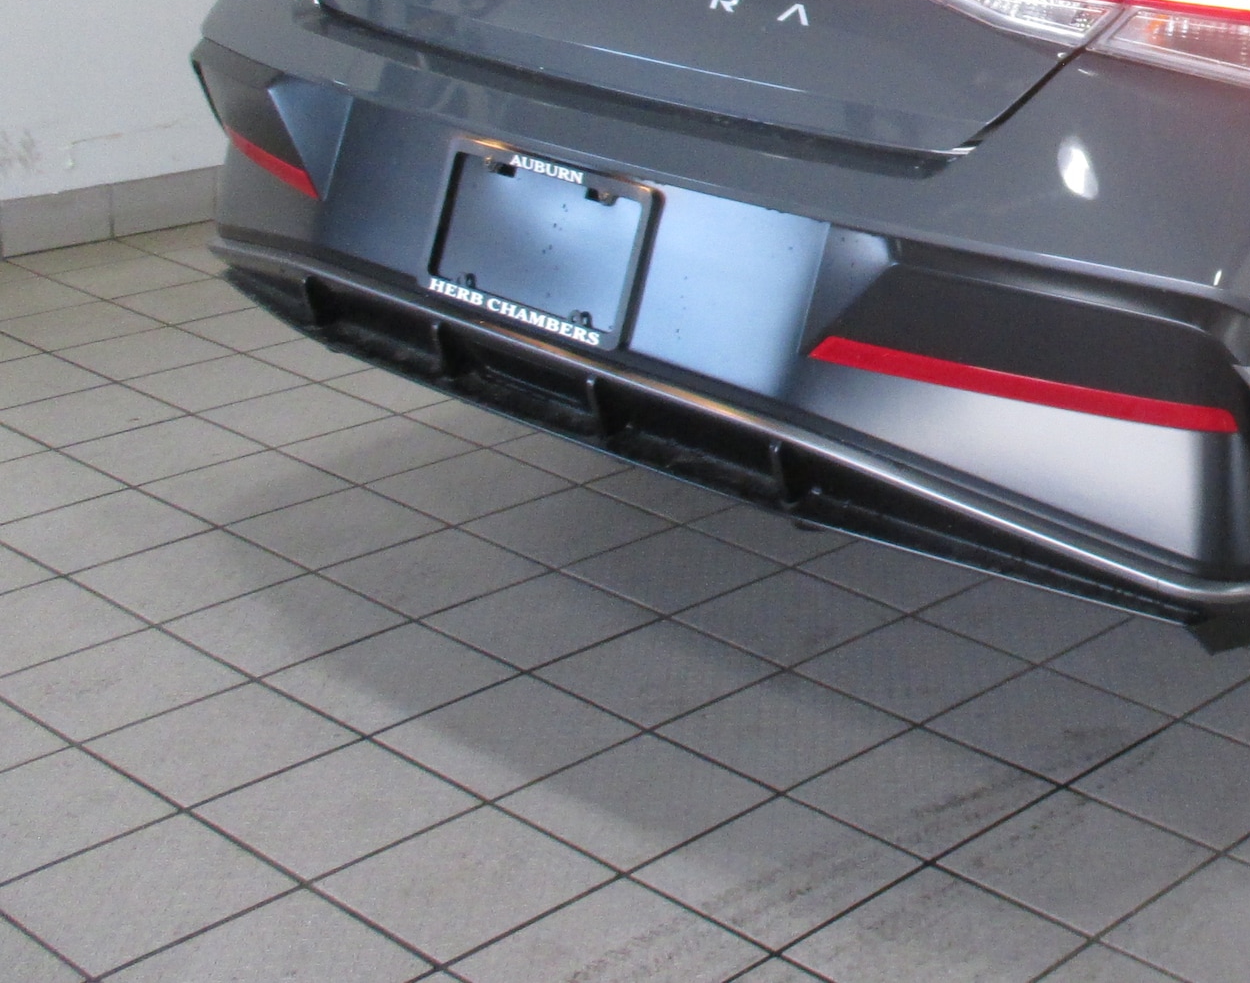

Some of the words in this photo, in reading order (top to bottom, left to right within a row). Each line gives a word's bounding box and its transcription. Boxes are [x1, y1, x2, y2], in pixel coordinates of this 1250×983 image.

[510, 154, 583, 184] AUBURN
[428, 278, 484, 306] HERB
[487, 298, 600, 346] CHAMBERS
